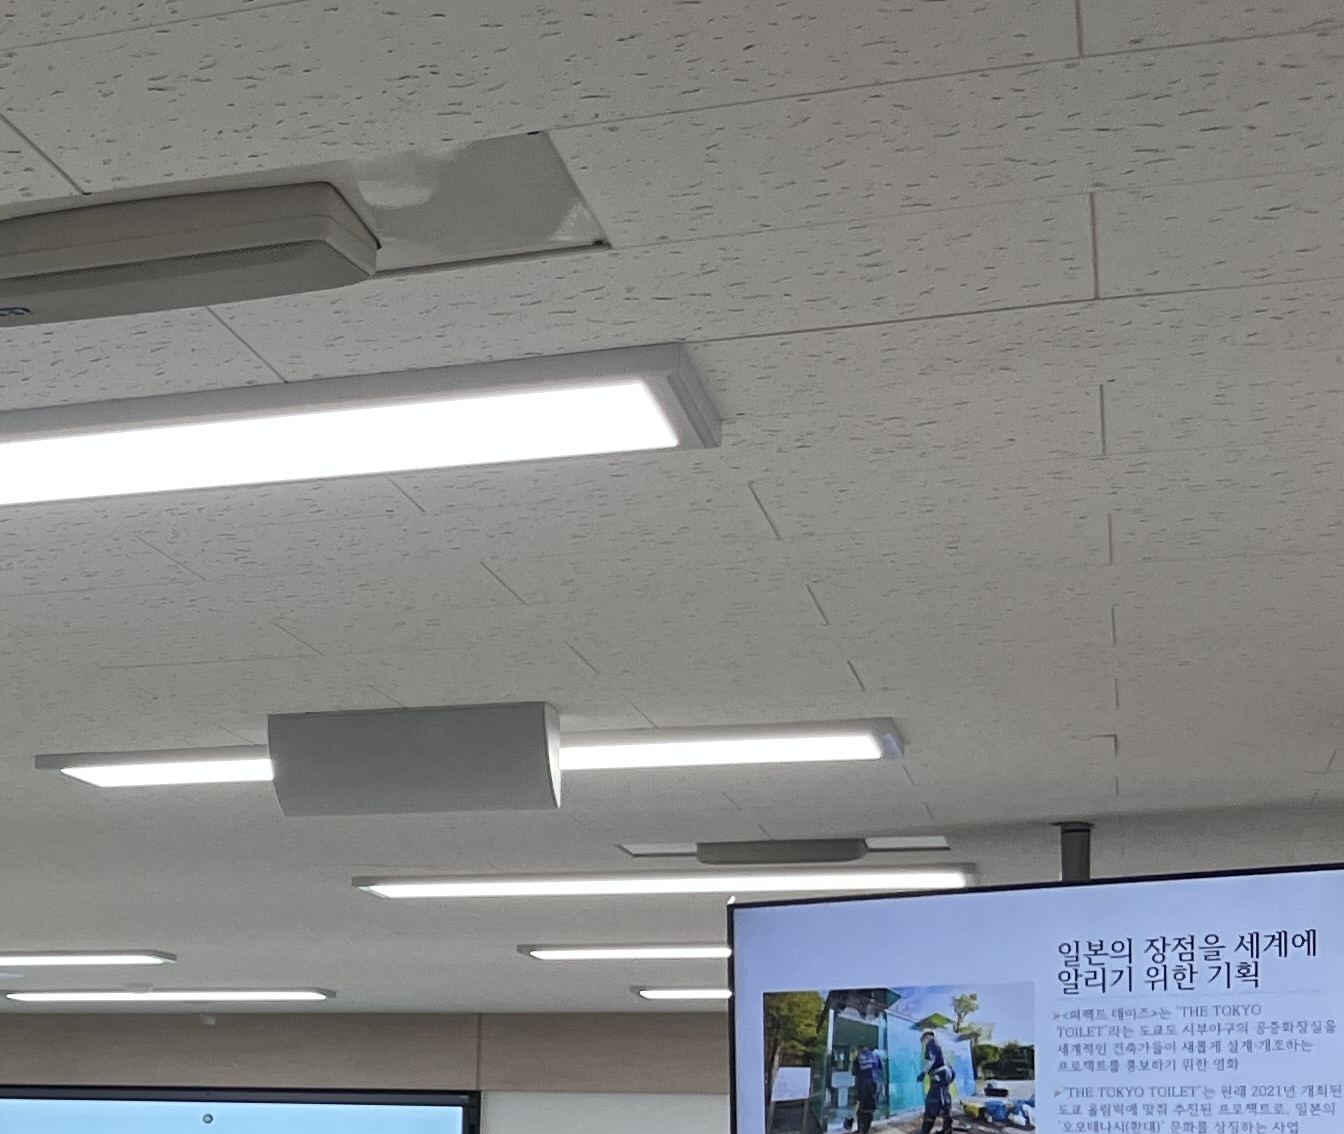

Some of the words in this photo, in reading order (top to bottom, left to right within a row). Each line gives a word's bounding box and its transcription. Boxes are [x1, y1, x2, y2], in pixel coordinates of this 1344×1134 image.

[1057, 937, 1133, 967] 일본의
[1144, 934, 1226, 964] 장점을
[1234, 929, 1316, 959] 세계에
[1057, 966, 1133, 995] 알리기
[1144, 963, 1198, 991] 위한
[1207, 961, 1260, 989] 기획
[1212, 1003, 1262, 1017] TOKYO
[1182, 1021, 1249, 1037] 시부야구의
[1256, 1019, 1337, 1036] 공중화장실을
[1098, 1085, 1144, 1099] TOKYO
[1251, 1084, 1297, 1099] 2021년
[1294, 1101, 1336, 1117] 일본의
[1214, 1119, 1268, 1134] 상징하는
[1272, 1119, 1299, 1134] 사업
